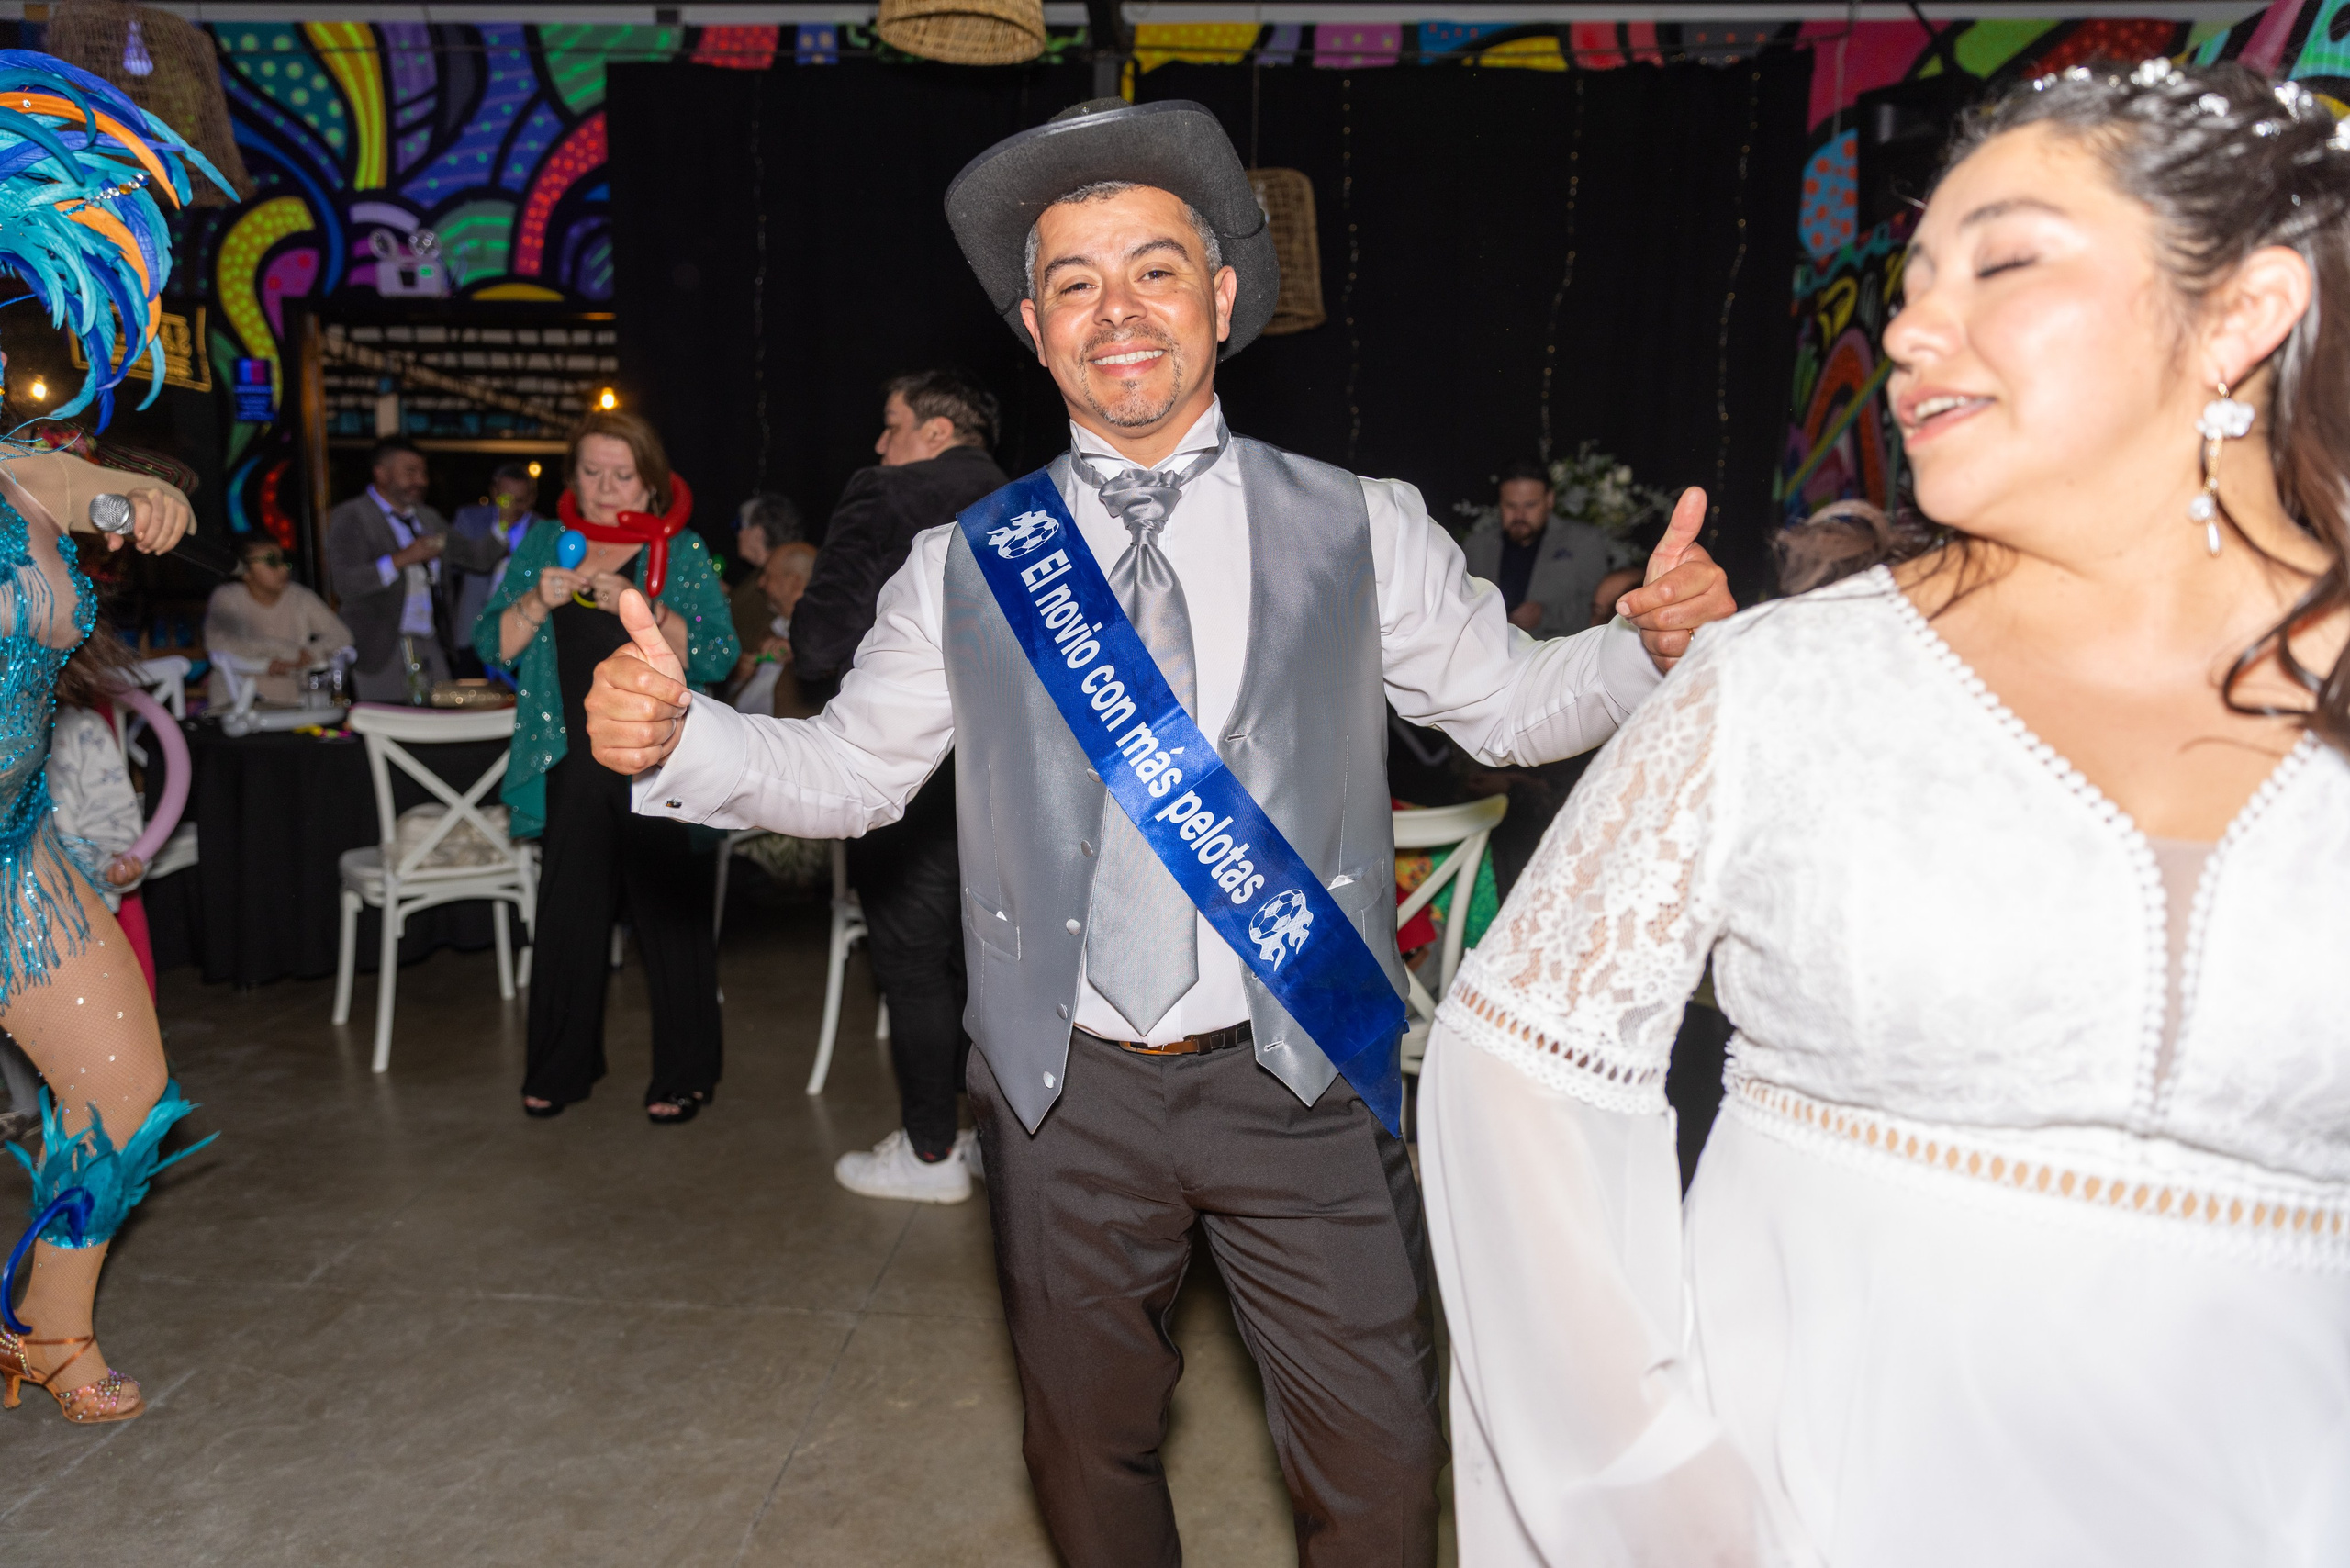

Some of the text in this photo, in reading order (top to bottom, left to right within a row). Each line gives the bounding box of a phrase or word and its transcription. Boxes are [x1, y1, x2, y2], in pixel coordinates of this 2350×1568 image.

[1020, 548, 1265, 905] El novio con más pelotas
